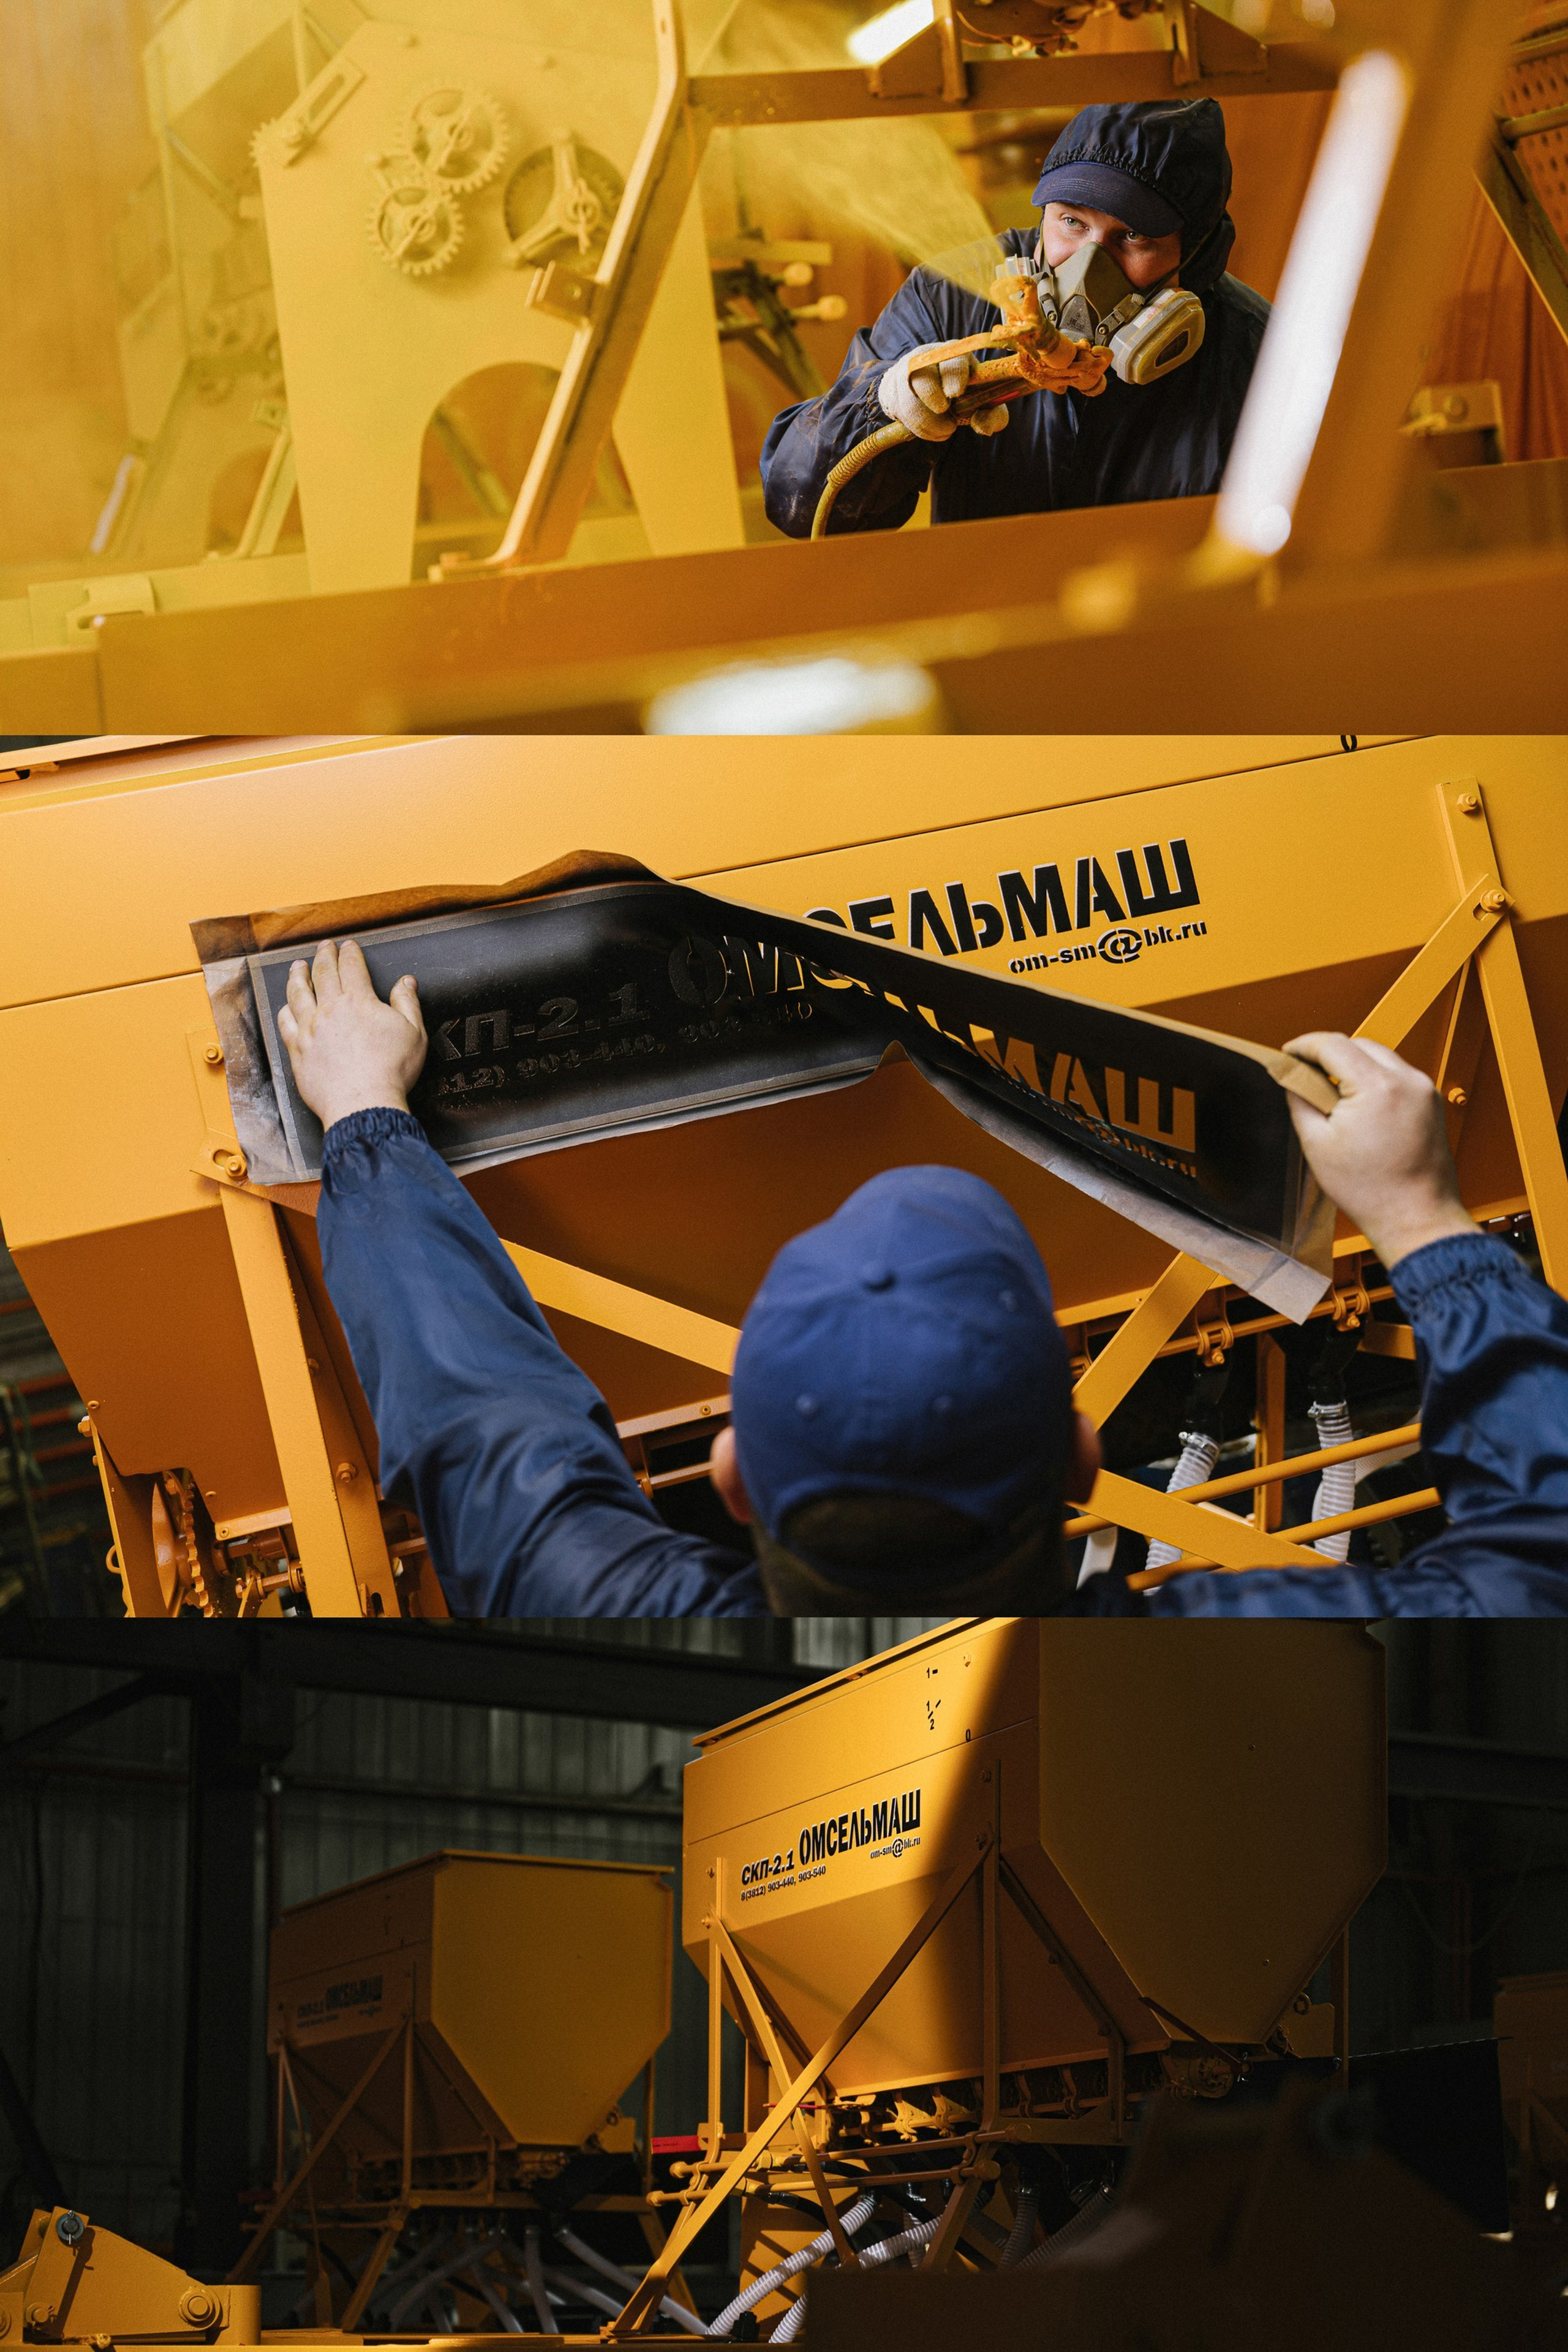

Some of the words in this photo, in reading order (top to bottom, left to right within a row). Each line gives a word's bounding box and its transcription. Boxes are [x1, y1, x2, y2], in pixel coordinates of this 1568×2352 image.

[1008, 919, 1208, 974] om-sm@bk.ru
[430, 983, 651, 1061] КП-2.1
[741, 1848, 794, 1885] СКП-2.1
[799, 1788, 921, 1866] ОМСЕЛЬМАШ
[870, 1836, 921, 1858] om-sm@bk.ru
[741, 1885, 766, 1901] 8(3812)
[767, 1876, 796, 1892] 903-440,
[798, 1864, 826, 1882] 903-540
